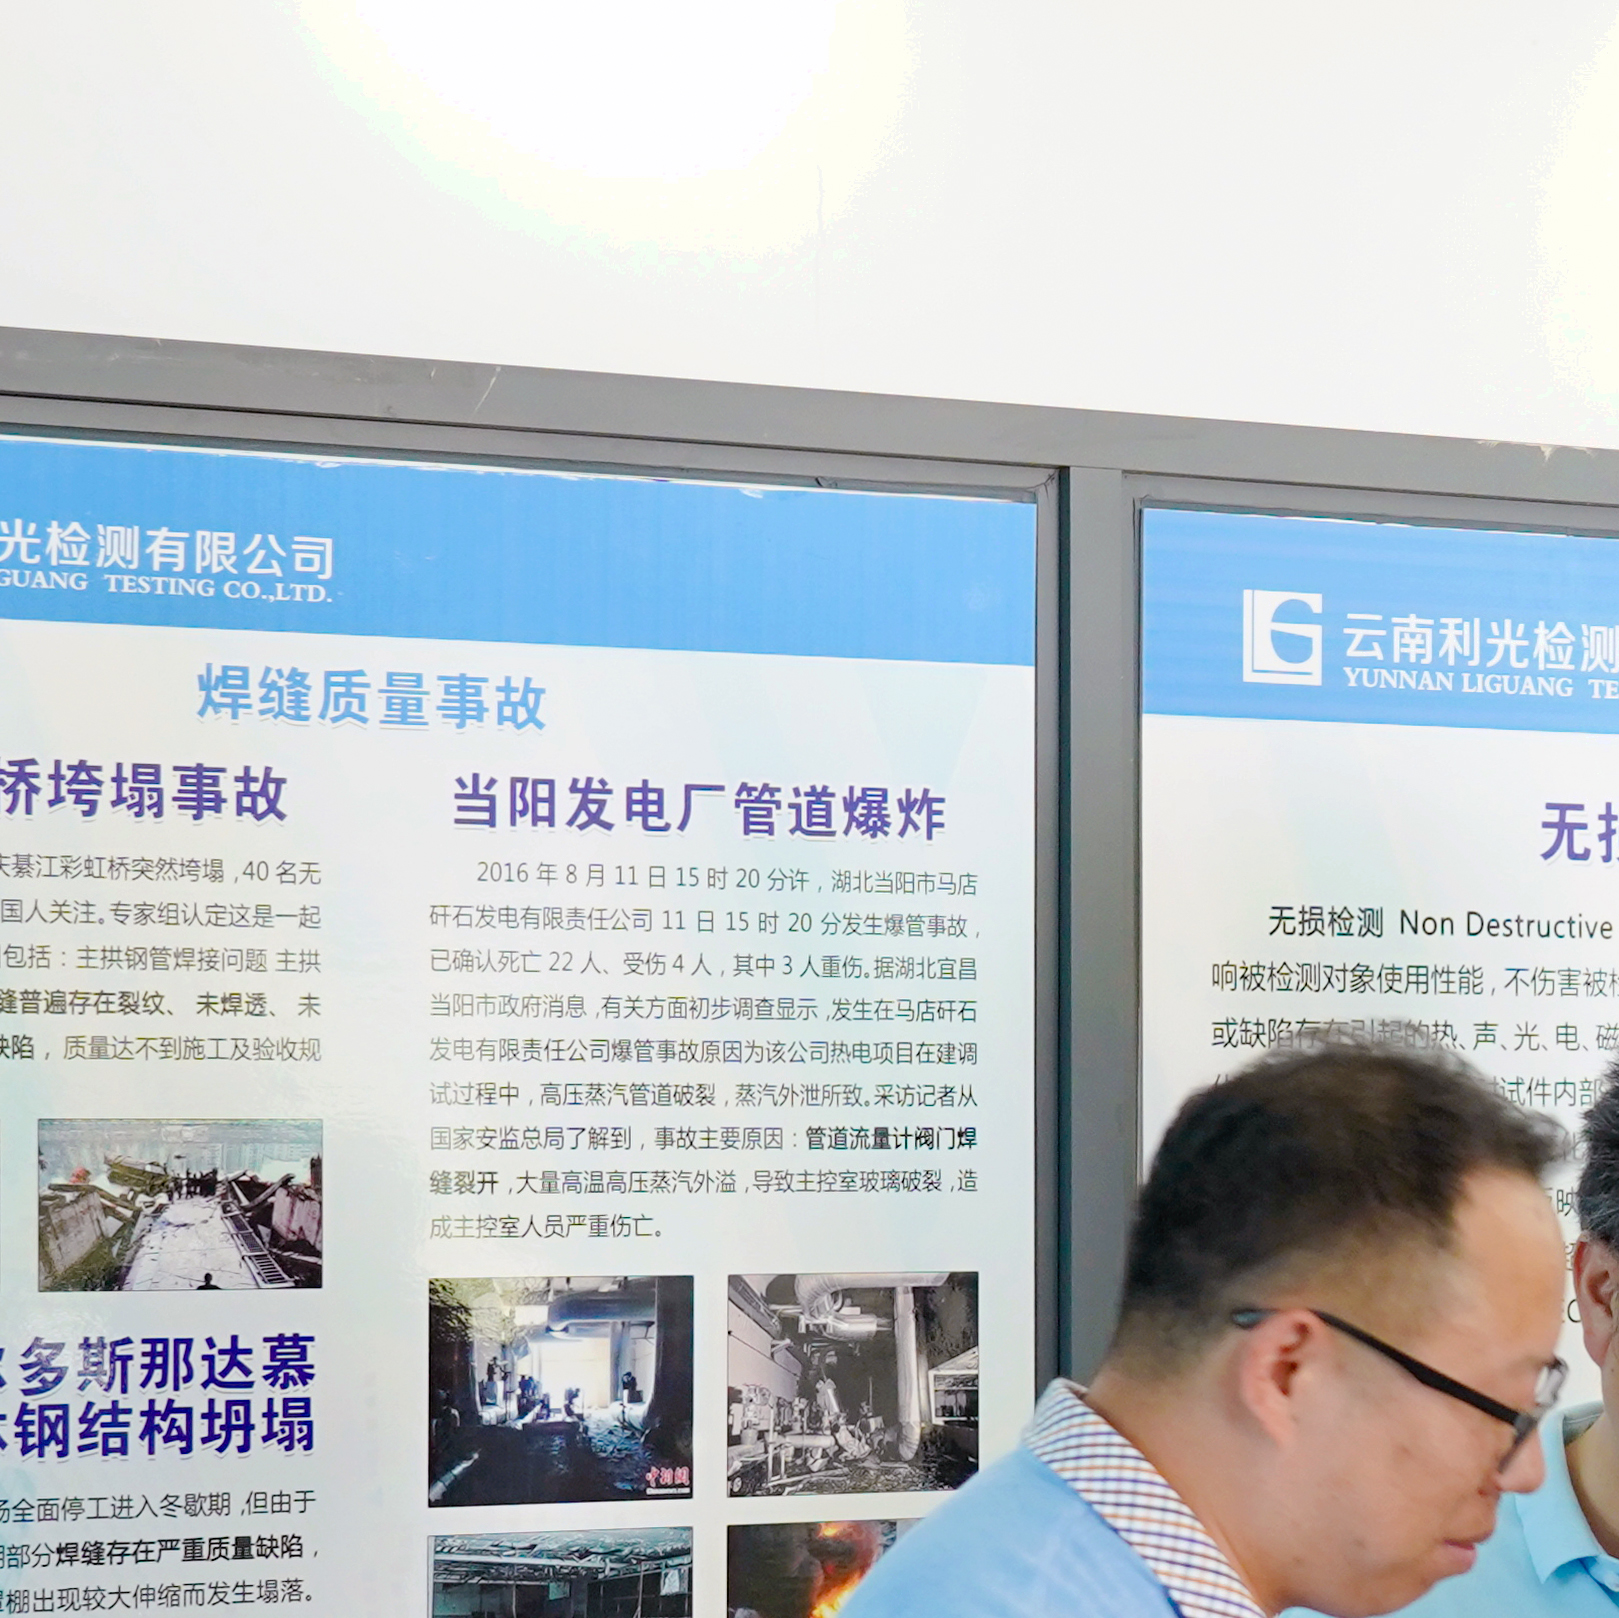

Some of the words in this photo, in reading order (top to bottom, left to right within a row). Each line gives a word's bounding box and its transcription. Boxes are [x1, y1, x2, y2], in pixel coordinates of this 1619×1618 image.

[0, 519, 333, 580] 光检测有限公司
[104, 573, 215, 598] TESTING
[222, 580, 333, 603] CO.,LTD.
[197, 663, 547, 730] 焊缝质量事故
[1343, 667, 1453, 691] YUNNAN
[1461, 672, 1574, 698] LIGUANG
[0, 757, 288, 822] 桥垮塌事故
[453, 772, 946, 841] 当阳发电厂管道爆炸
[1269, 905, 1383, 939] 无损检测
[1400, 909, 1454, 936] Non
[1466, 911, 1613, 940] Destructive
[1490, 1074, 1602, 1109] 试件内部
[0, 1333, 315, 1396] 多斯那达慕
[0, 1533, 318, 1569] 部分焊缝存在严重质量缺陷，
[0, 1577, 312, 1614] 棚出现较大伸缩而发生塌落。
